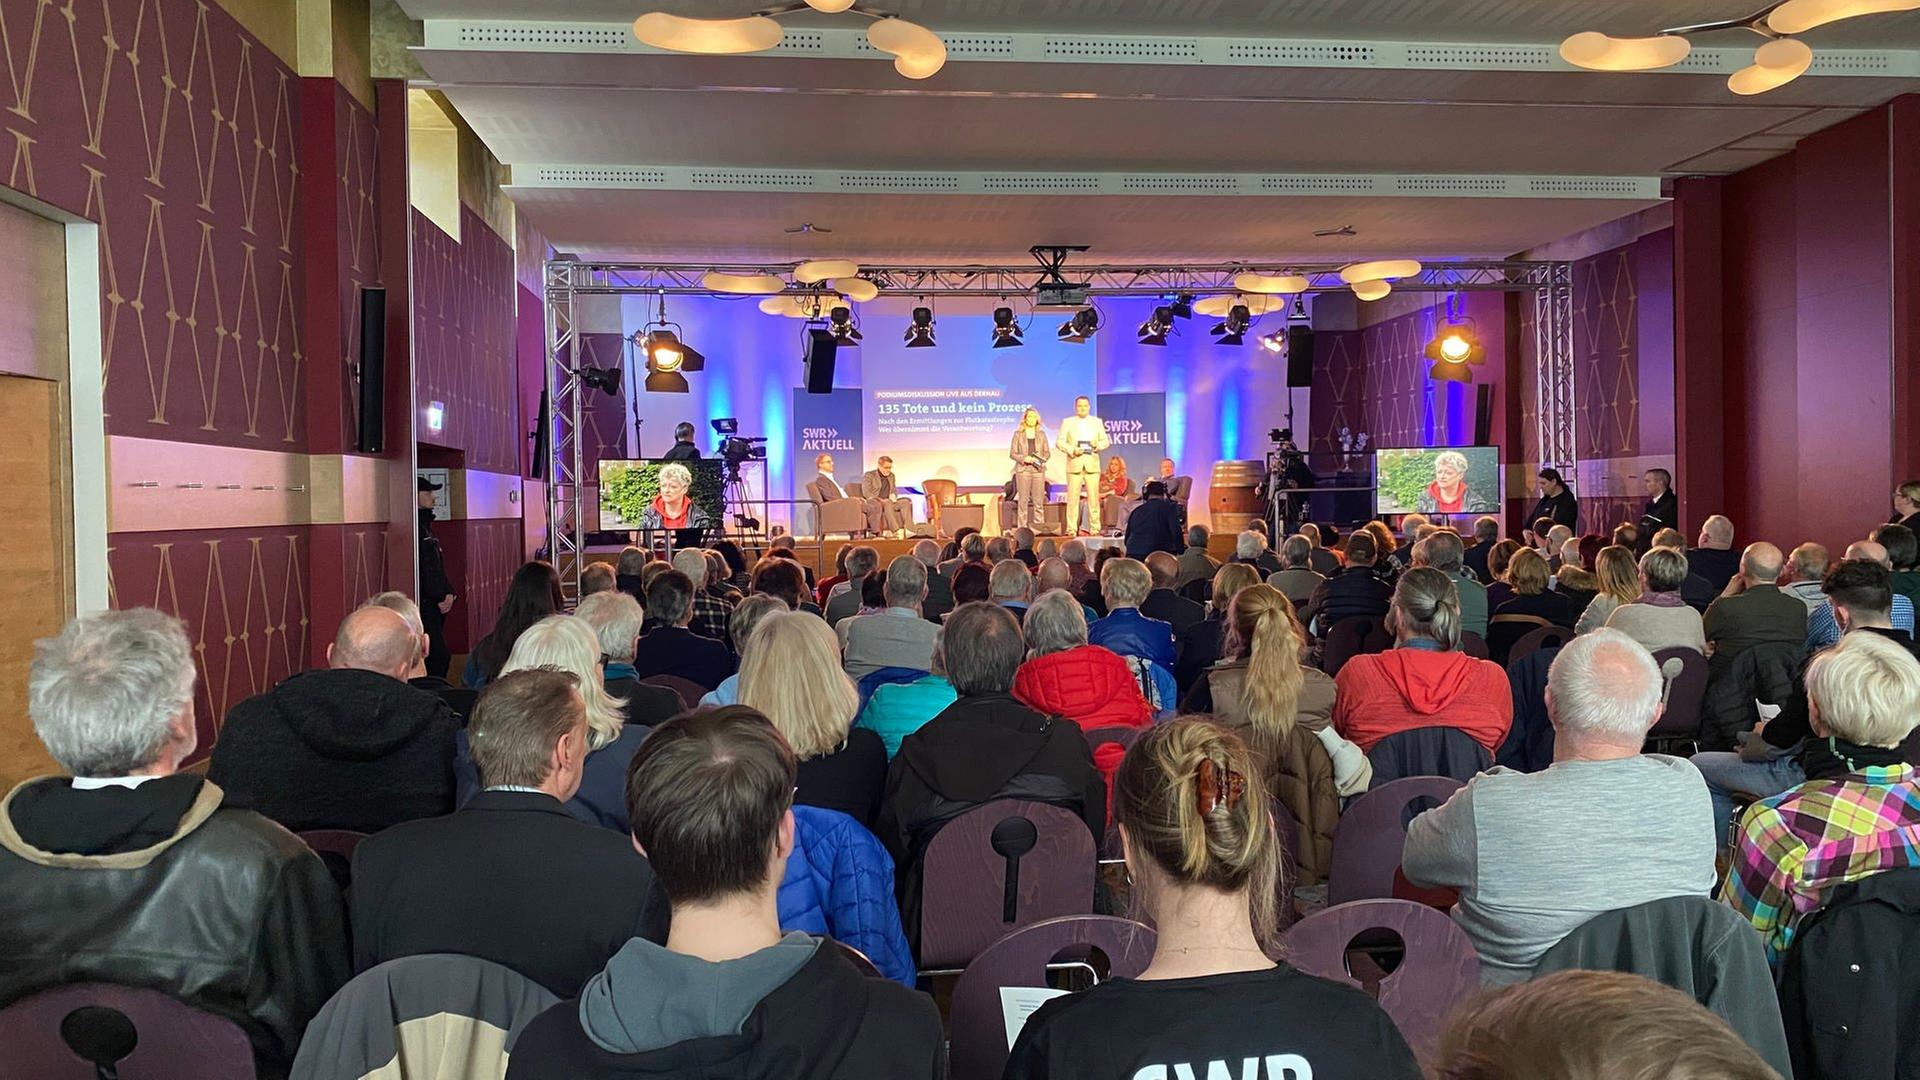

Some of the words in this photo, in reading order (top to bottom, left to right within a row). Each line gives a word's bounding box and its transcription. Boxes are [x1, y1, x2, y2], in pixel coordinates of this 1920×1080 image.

[960, 390, 973, 398] AUS
[879, 404, 900, 414] 135
[902, 403, 929, 414] Tote
[932, 402, 956, 413] und
[958, 402, 986, 413] kein
[1104, 420, 1130, 432] SWR
[802, 427, 827, 439] SWR
[802, 439, 855, 450] AKTUELL
